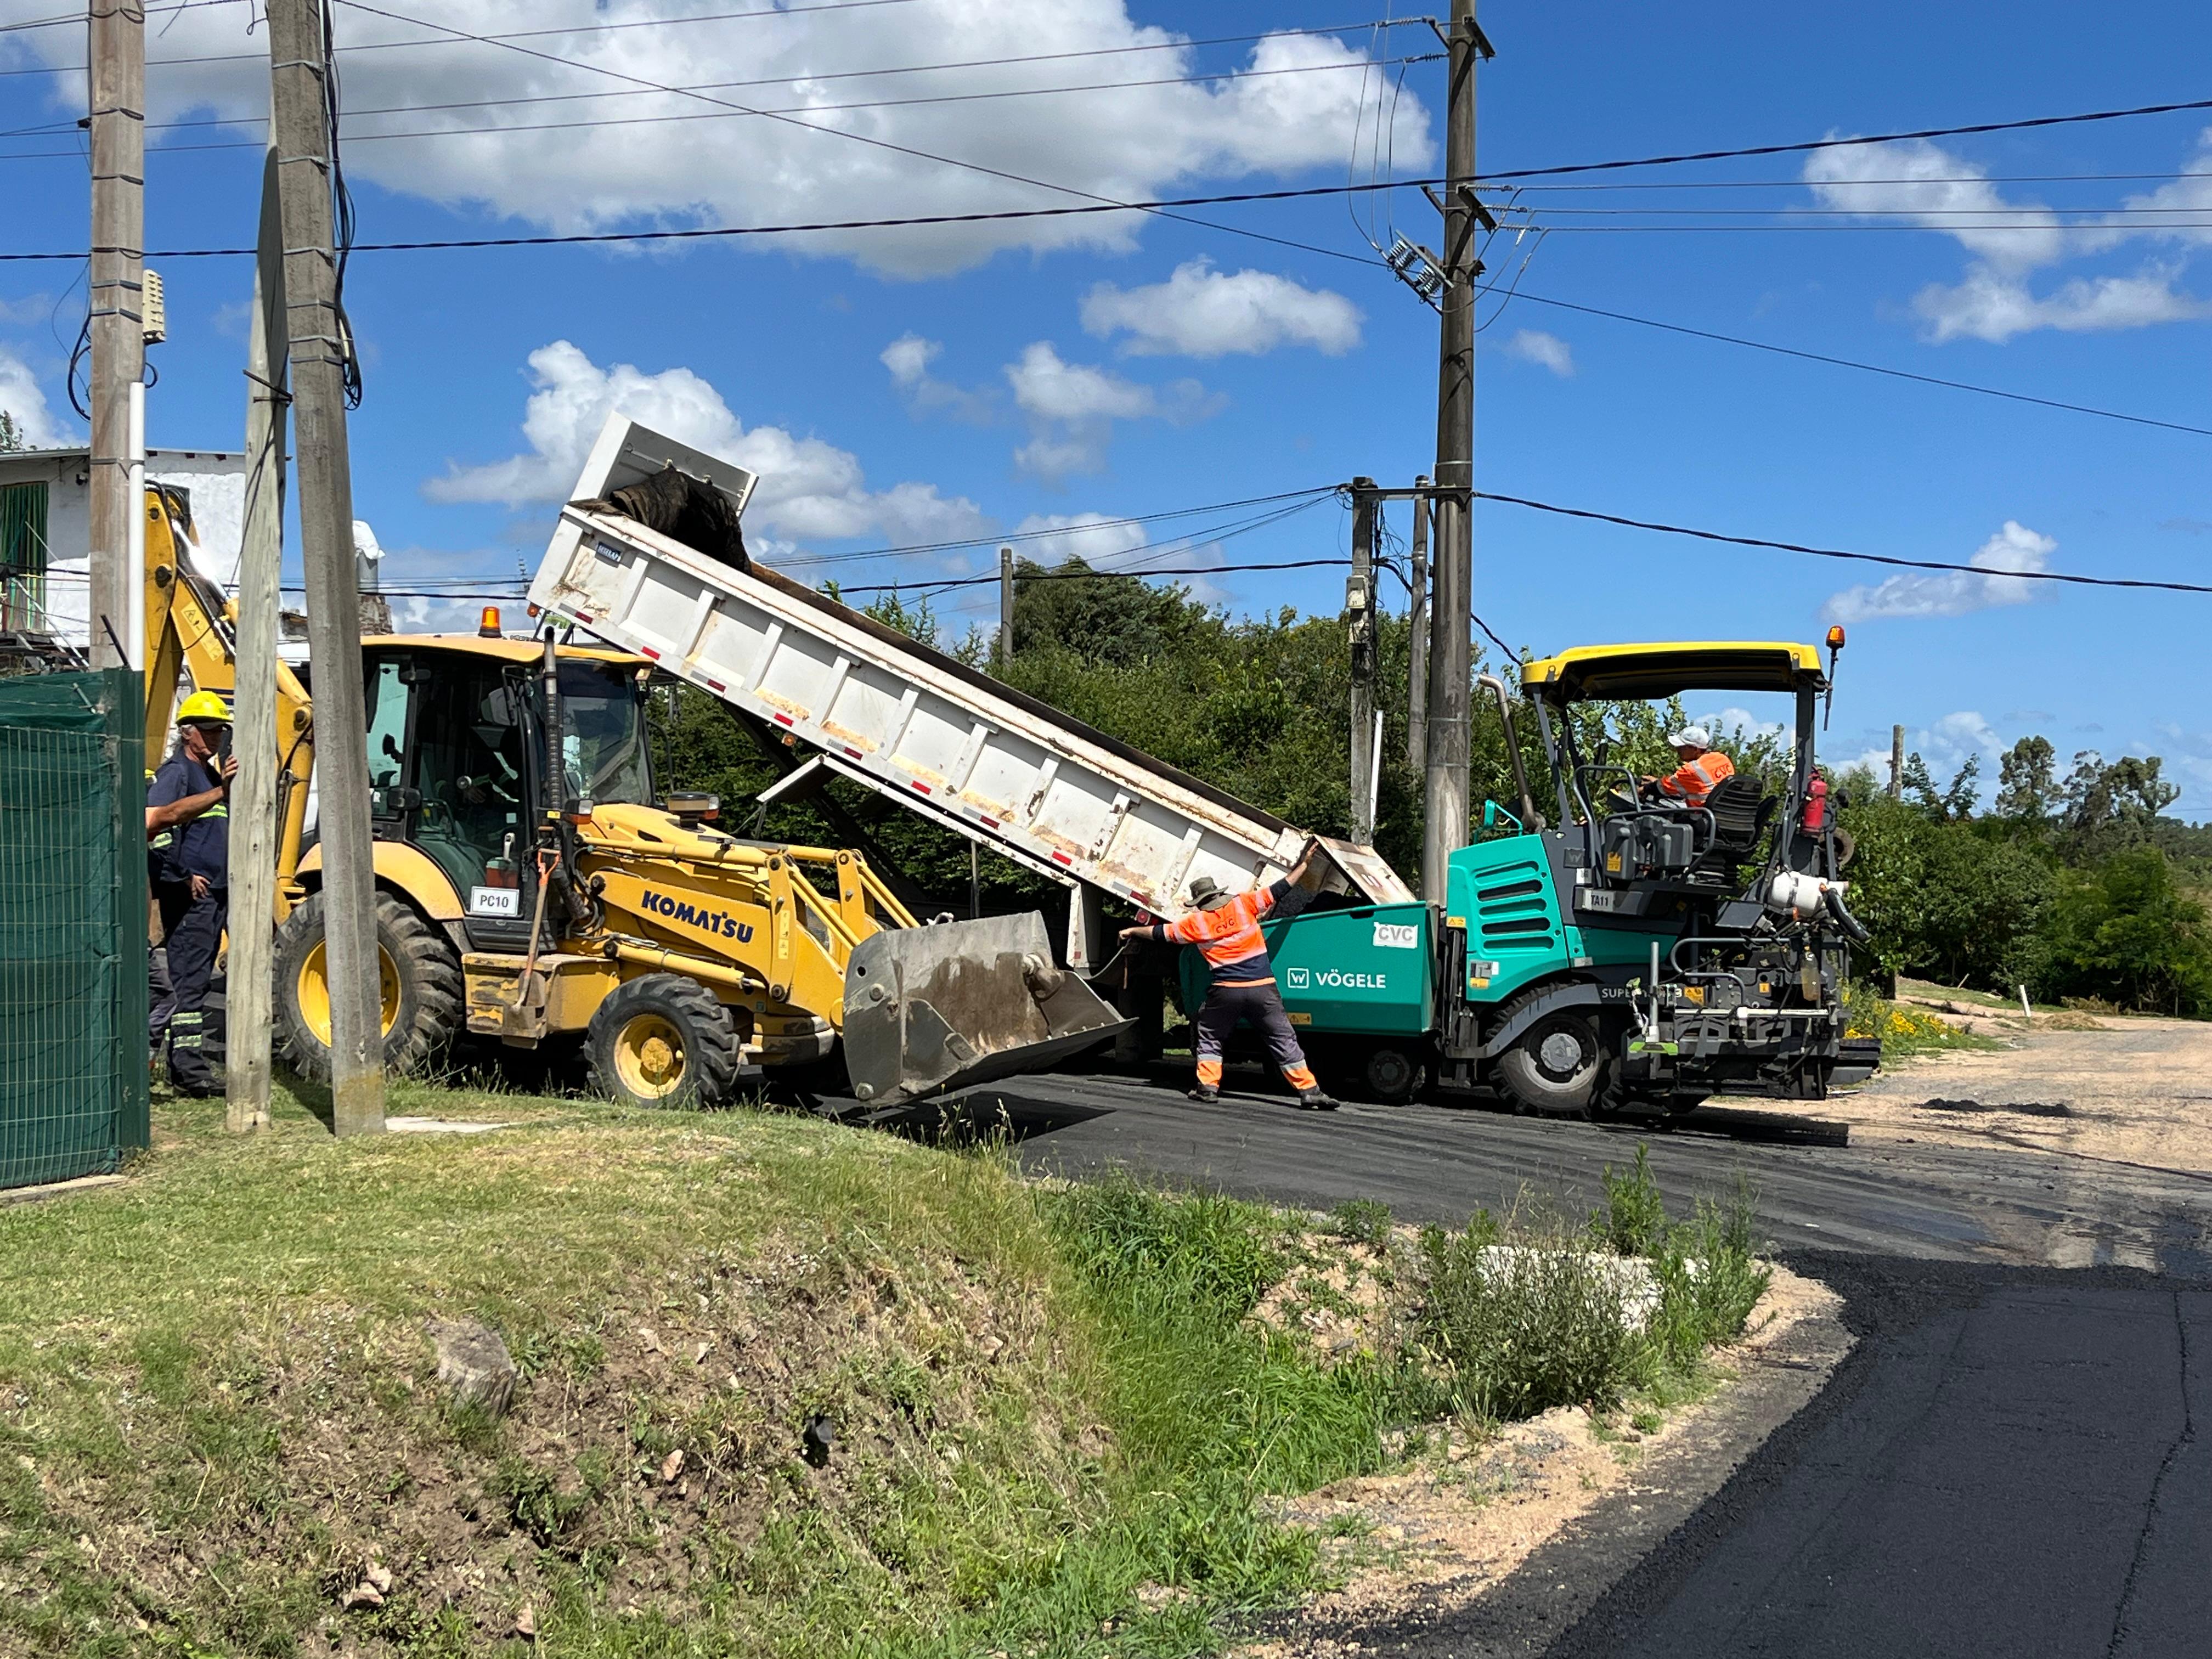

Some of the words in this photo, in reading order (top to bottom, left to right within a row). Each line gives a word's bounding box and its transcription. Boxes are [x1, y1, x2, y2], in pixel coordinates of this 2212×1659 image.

[480, 895, 509, 907] PC10
[1591, 895, 1609, 906] TA11
[641, 890, 754, 943] KOMATSU
[1378, 927, 1413, 941] CVC
[1315, 968, 1386, 988] VÖGELE
[1601, 988, 1633, 998] SUPE
